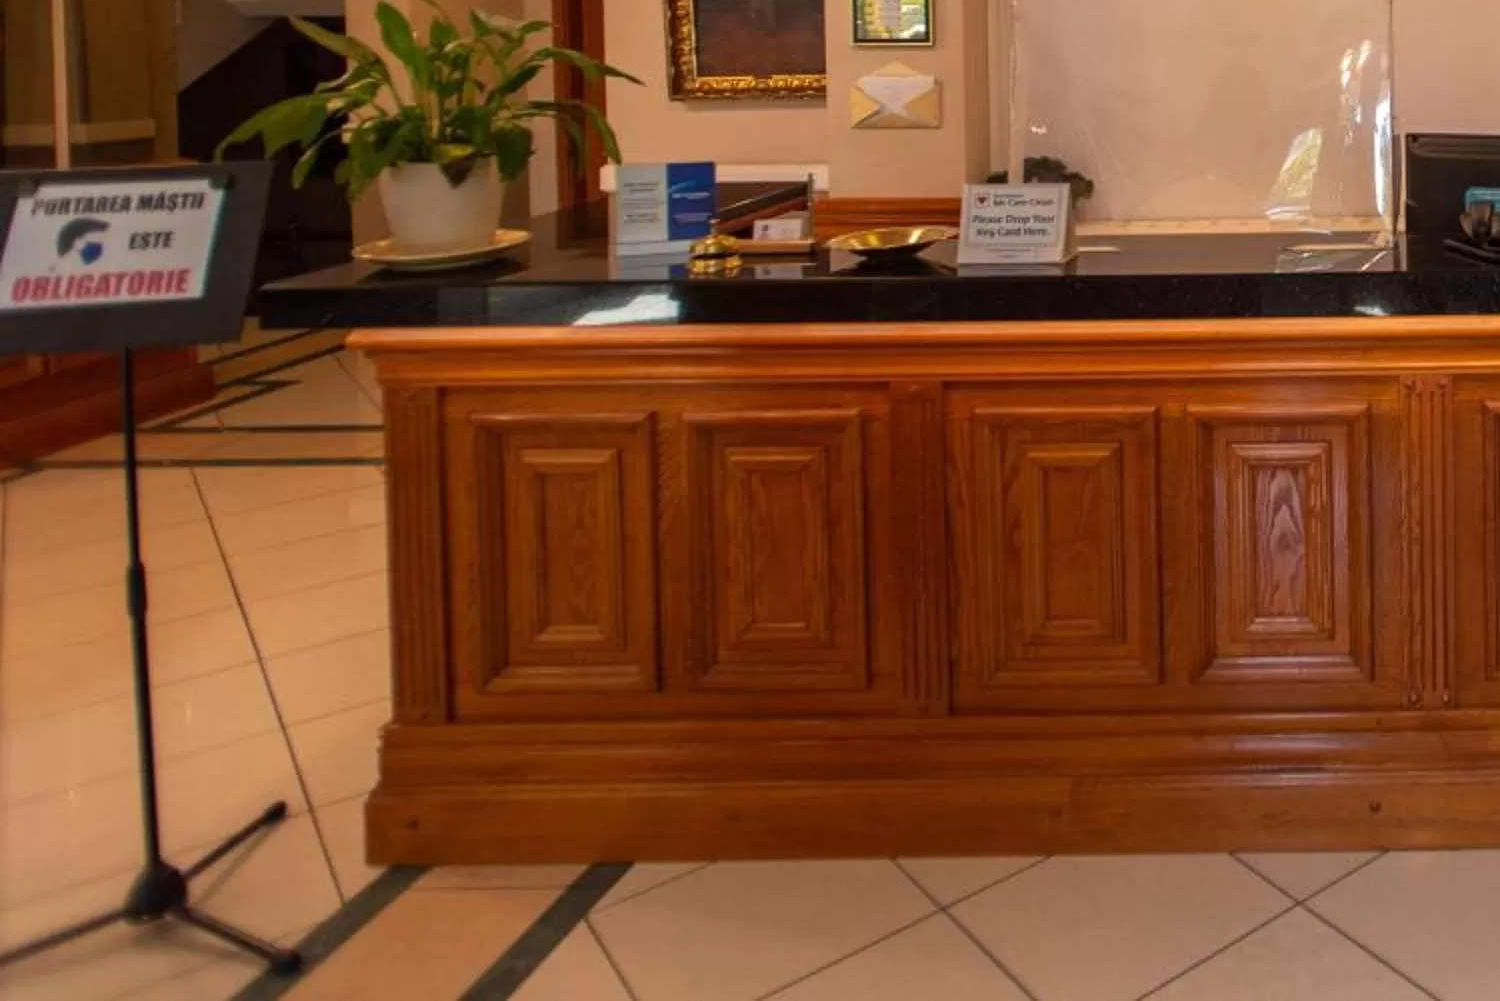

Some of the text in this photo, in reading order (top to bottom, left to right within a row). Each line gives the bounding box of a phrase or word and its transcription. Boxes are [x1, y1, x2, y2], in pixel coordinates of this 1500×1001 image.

[31, 194, 131, 216] PURTAREA
[972, 214, 1003, 224] Please
[1005, 214, 1030, 226] Drop
[128, 231, 175, 251] ESTE
[997, 226, 1021, 236] Card
[12, 268, 191, 303] OBLIGATORIE
